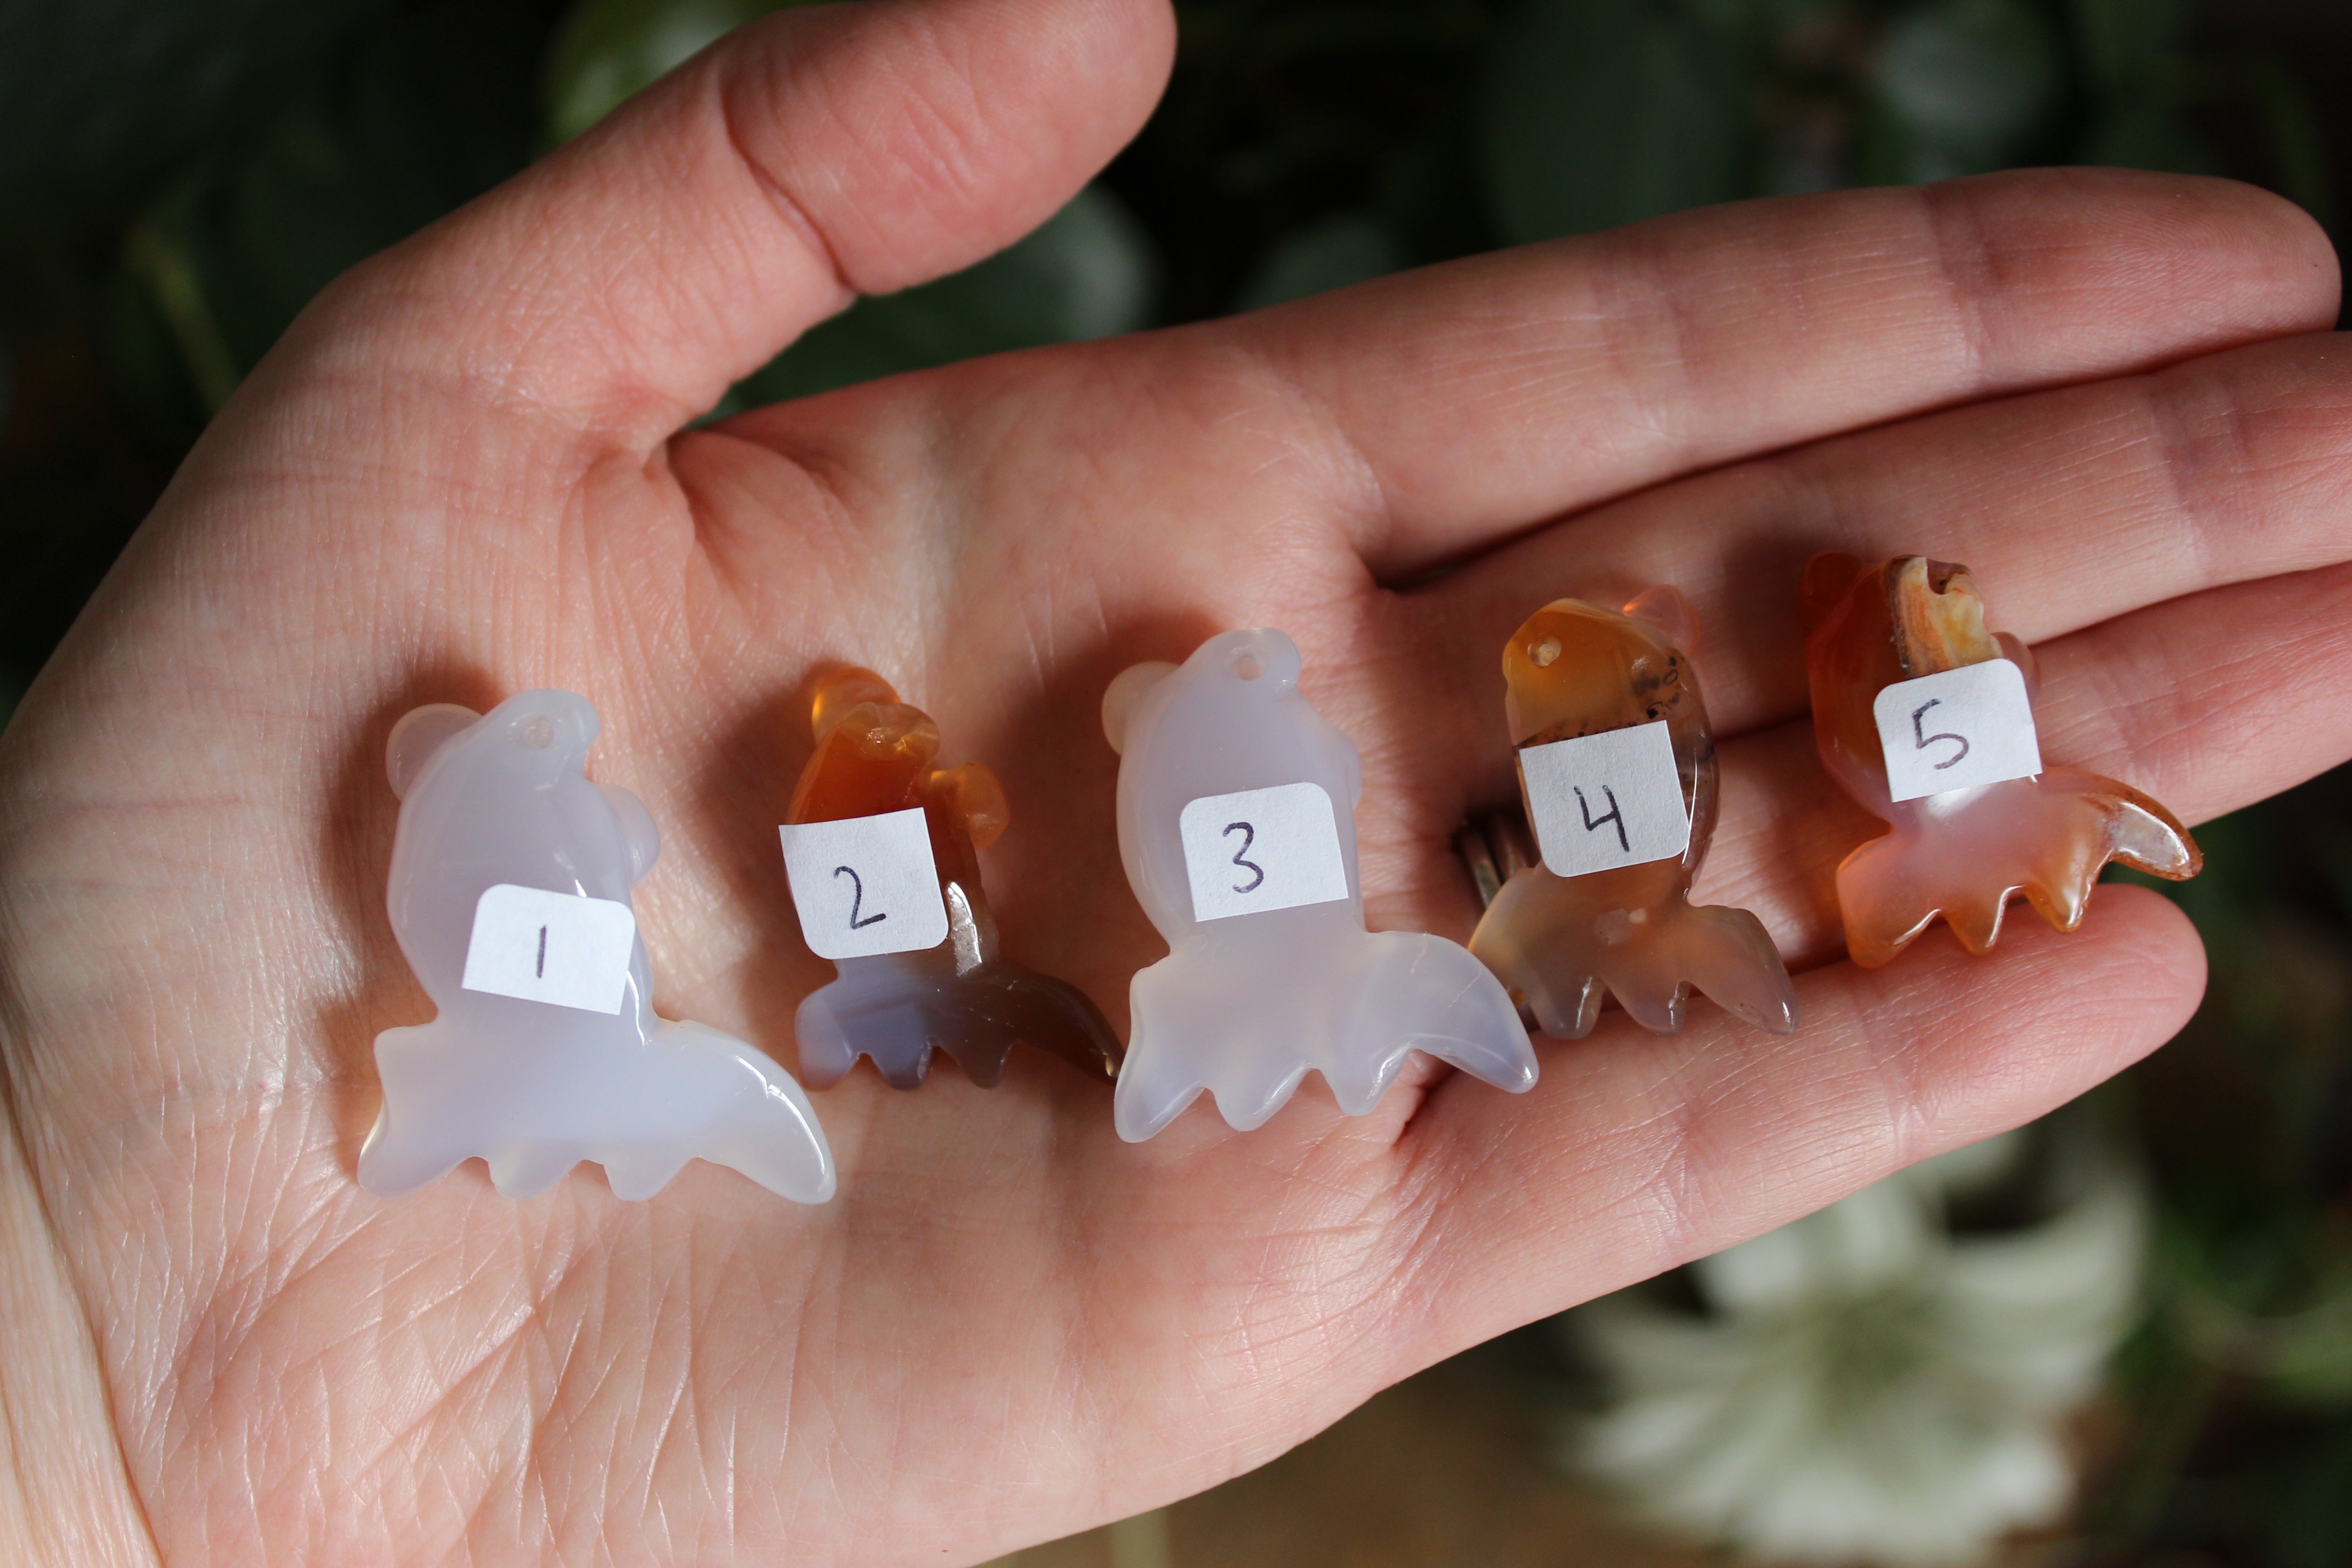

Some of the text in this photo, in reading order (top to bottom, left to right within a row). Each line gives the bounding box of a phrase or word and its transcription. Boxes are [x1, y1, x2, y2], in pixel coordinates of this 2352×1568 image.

[1912, 698, 1970, 770] 5
[1573, 784, 1631, 853] 4
[1223, 822, 1264, 894] 3
[833, 866, 887, 930] 2
[536, 925, 547, 979] 1
